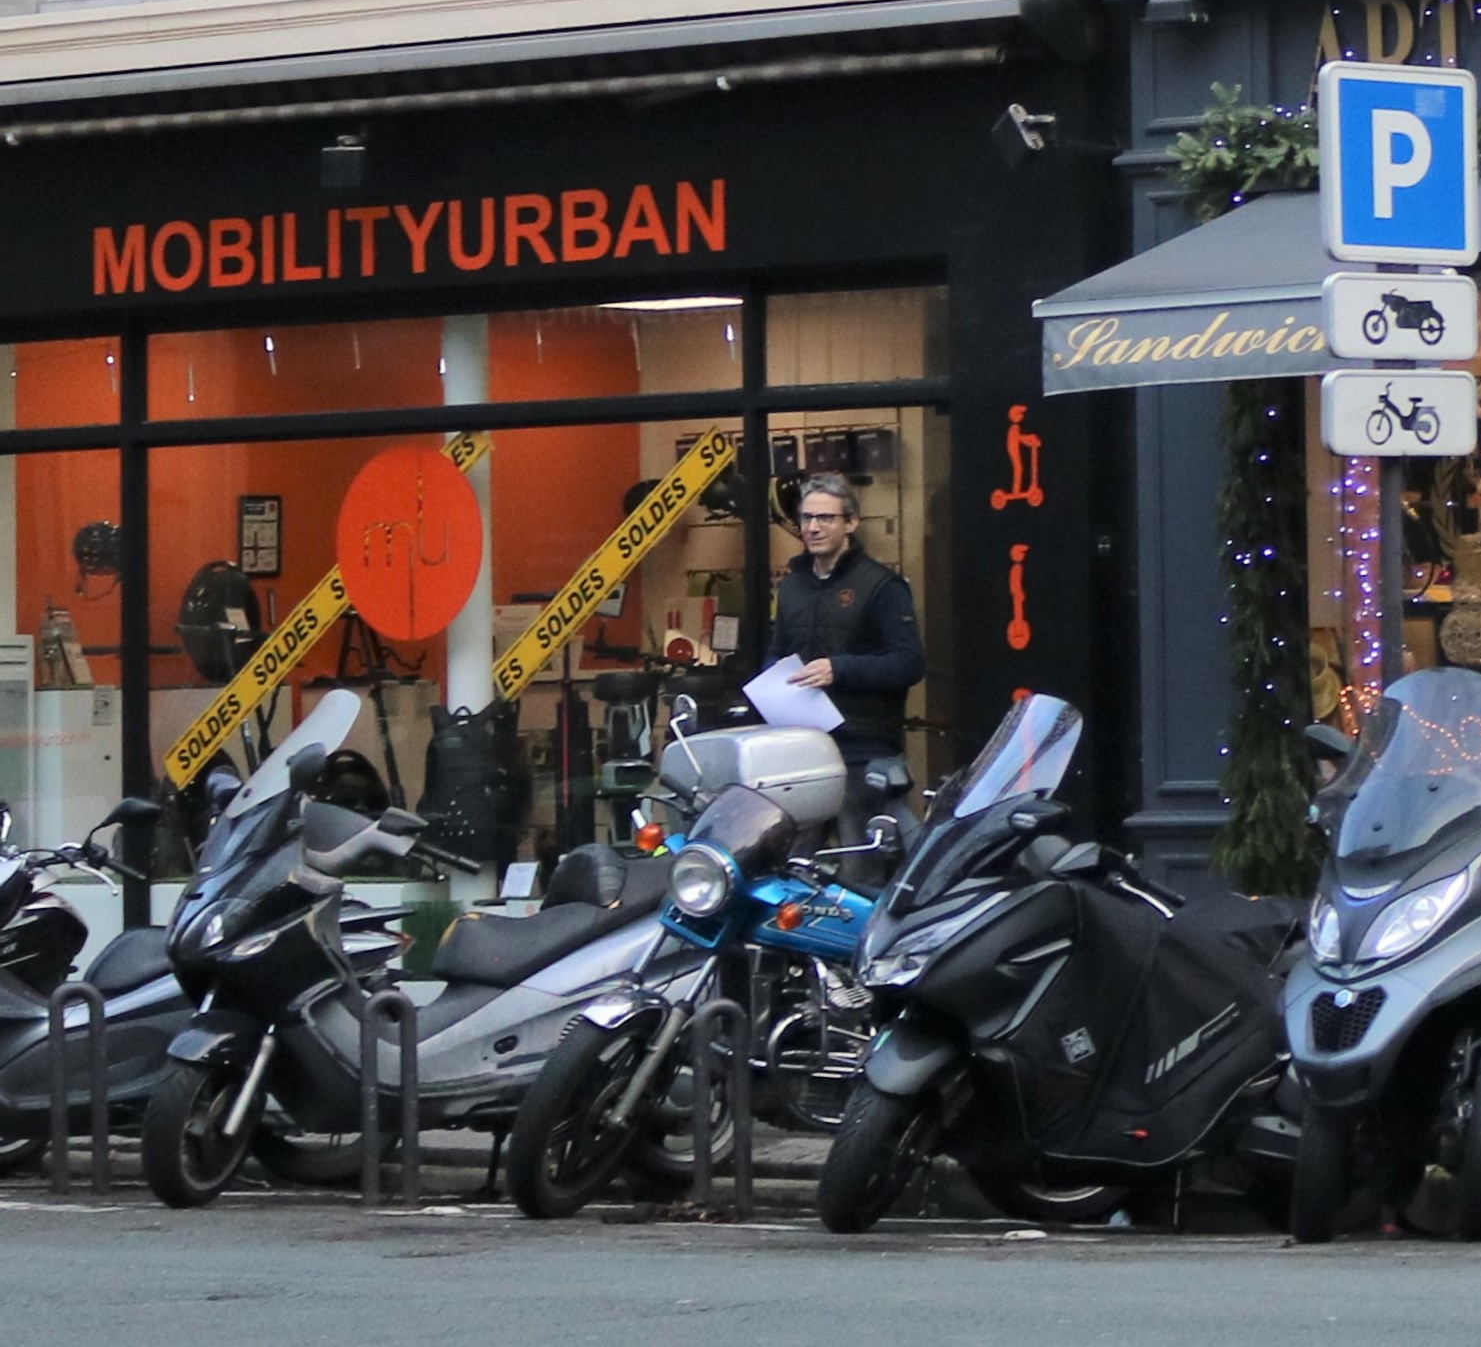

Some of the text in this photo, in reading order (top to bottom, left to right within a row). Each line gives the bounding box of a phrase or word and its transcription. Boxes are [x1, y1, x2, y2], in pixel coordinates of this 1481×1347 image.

[1371, 109, 1432, 219] P
[92, 179, 727, 295] MOBILITYURBAN
[1053, 311, 1325, 370] Sandwic
[618, 477, 687, 558] SOLDES
[252, 608, 319, 686] SOLDES
[536, 568, 605, 649] SOLDES
[177, 693, 242, 772] SOLDES
[800, 903, 856, 924] ONDA
